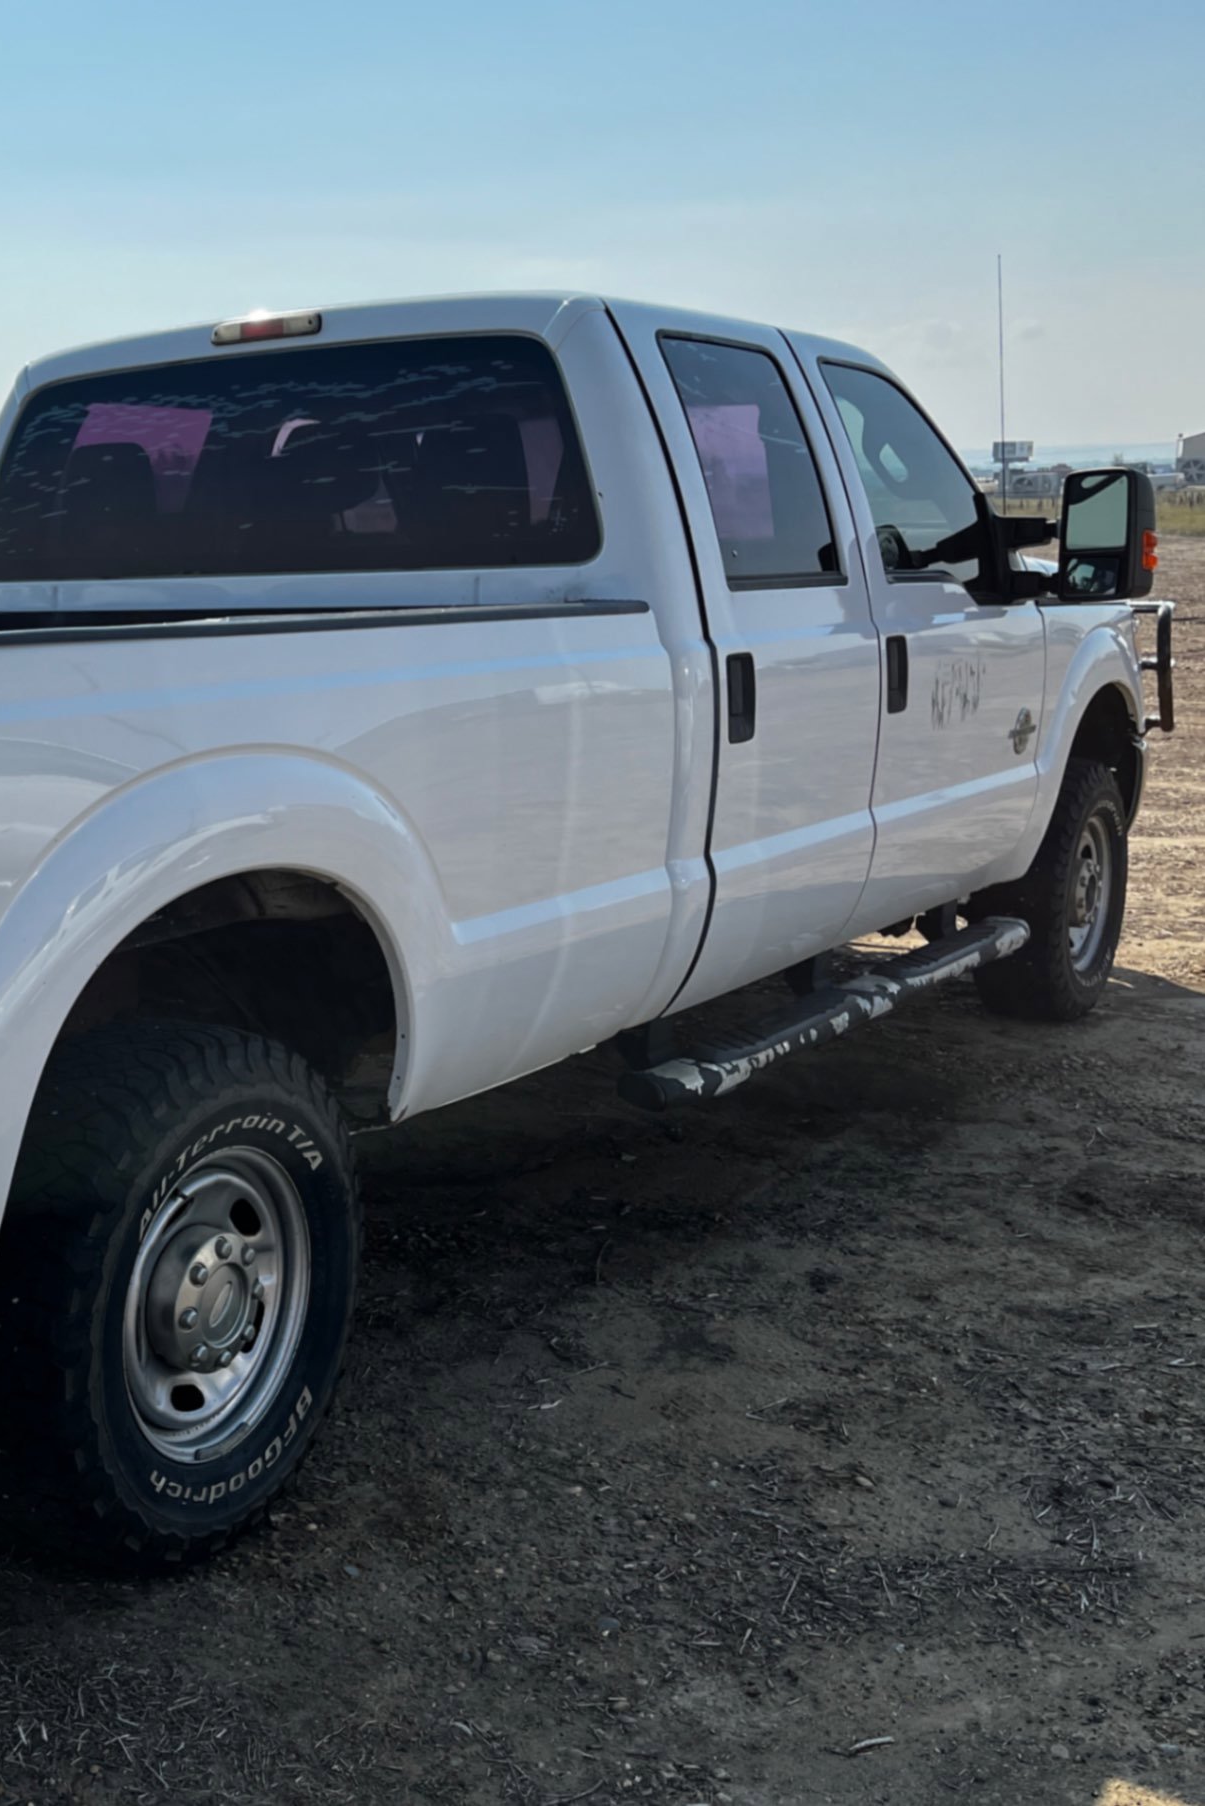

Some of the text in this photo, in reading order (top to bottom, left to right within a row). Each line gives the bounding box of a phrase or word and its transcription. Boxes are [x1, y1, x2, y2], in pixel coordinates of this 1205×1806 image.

[138, 1112, 324, 1241] All-Terrain T/A
[149, 1385, 313, 1505] BFGoodrich
